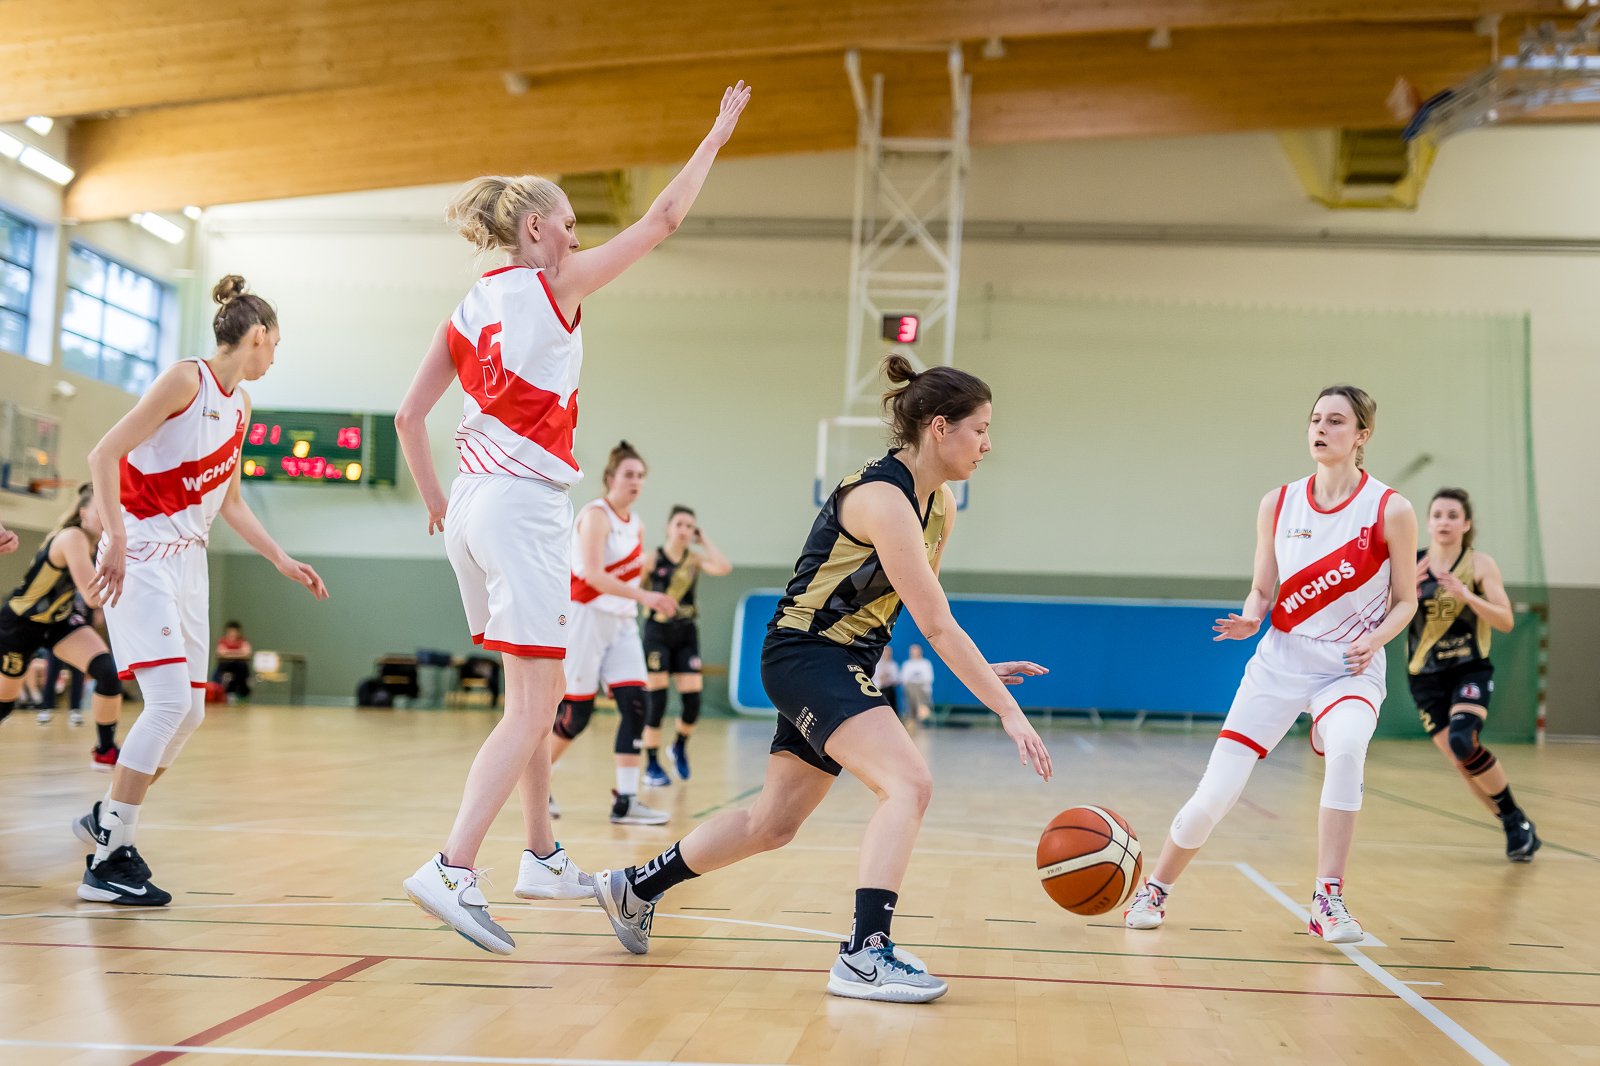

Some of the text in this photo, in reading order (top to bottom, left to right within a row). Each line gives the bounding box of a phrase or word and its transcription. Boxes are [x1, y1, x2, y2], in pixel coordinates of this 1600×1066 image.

[898, 316, 918, 342] 3
[1280, 558, 1356, 614] WICHOŚ
[855, 672, 882, 697] 8
